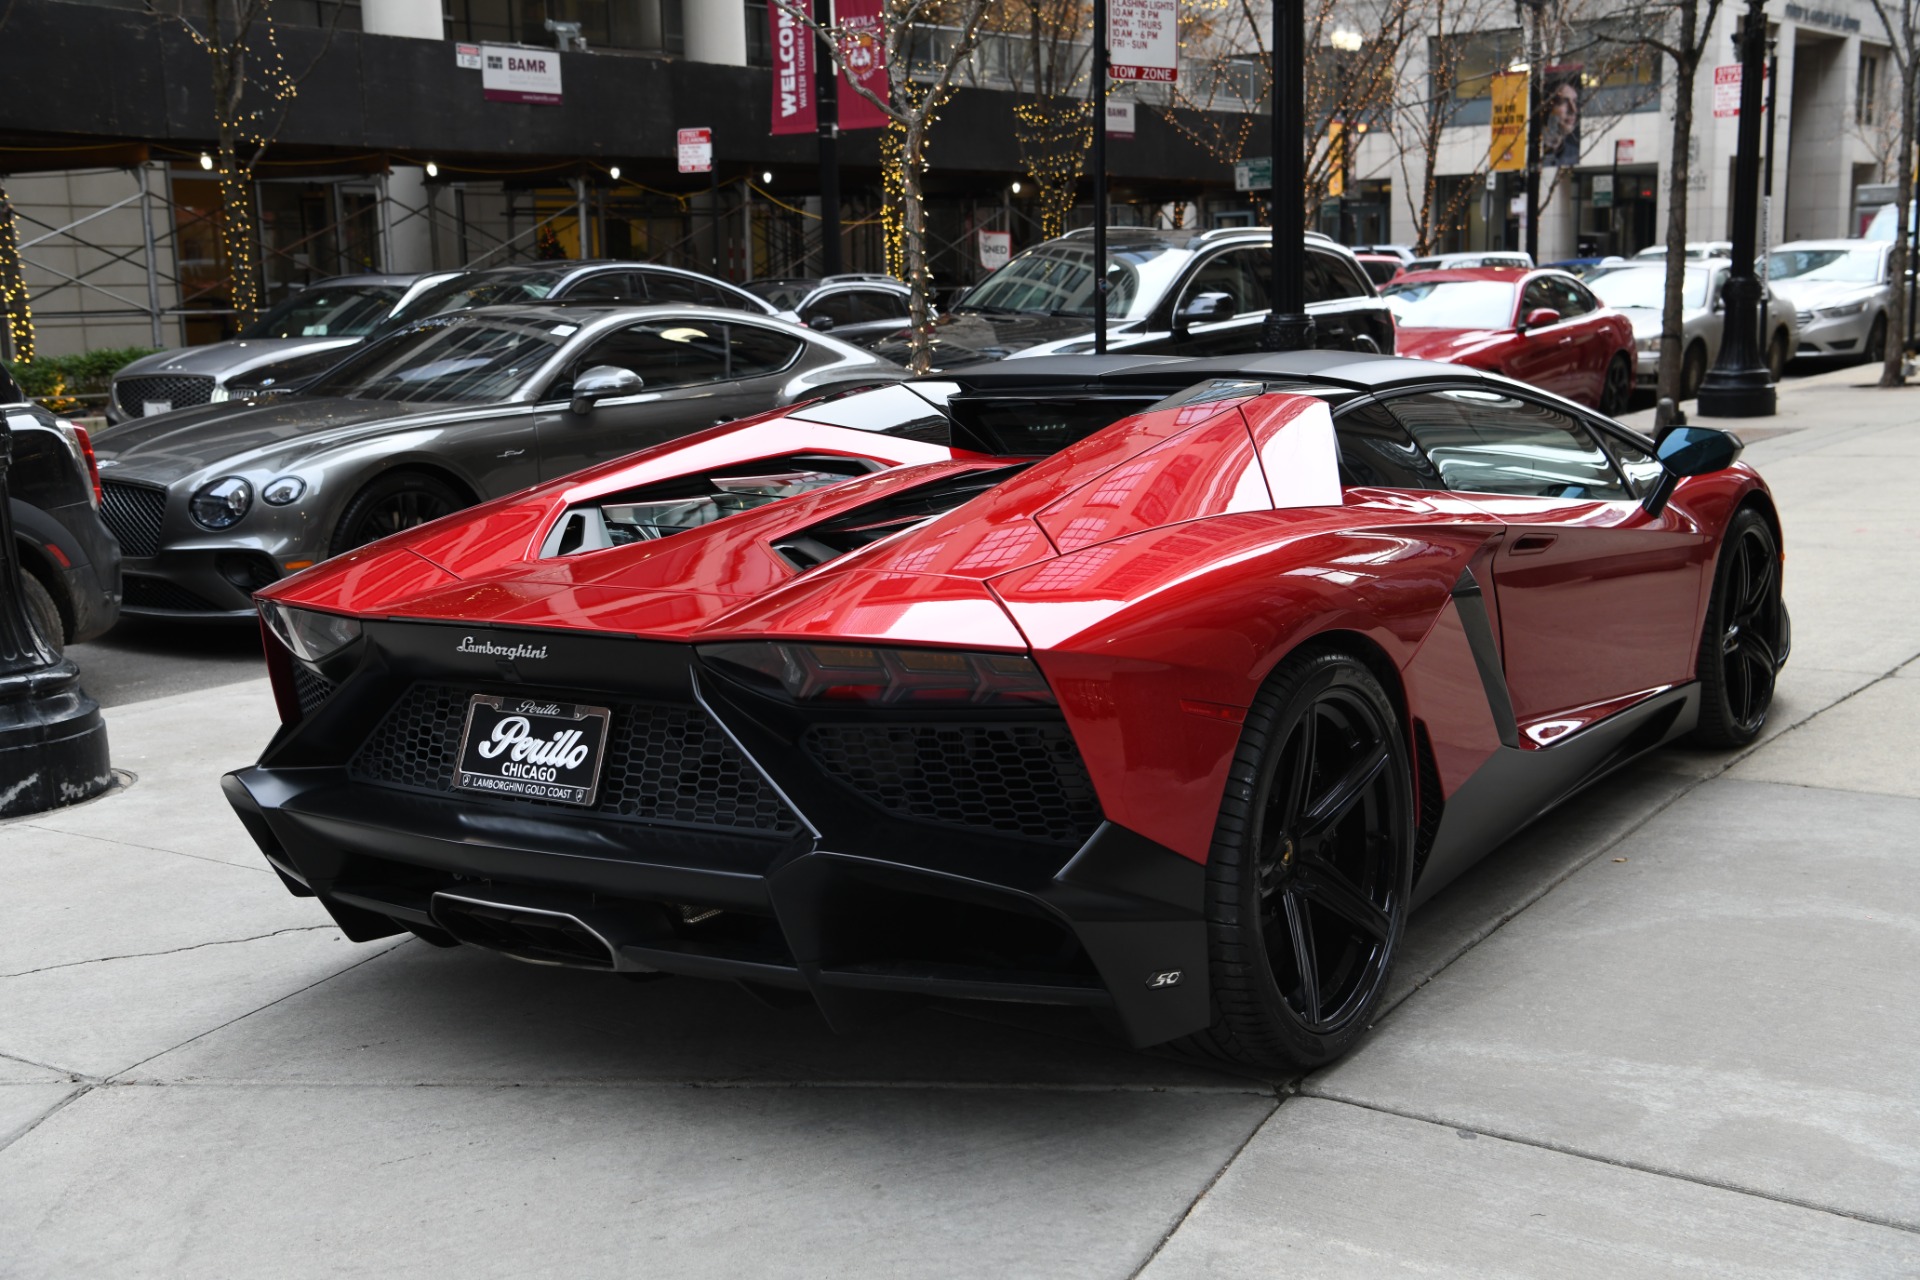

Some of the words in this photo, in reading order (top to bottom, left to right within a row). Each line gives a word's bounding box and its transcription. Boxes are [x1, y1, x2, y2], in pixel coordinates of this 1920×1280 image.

[1112, 0, 1149, 9] FLASHING
[1149, 1, 1175, 11] LIGHTS
[1112, 8, 1121, 16] 10
[1121, 9, 1134, 17] AM
[1140, 10, 1146, 19] 8
[1147, 11, 1159, 19] PM
[1112, 18, 1129, 27] MON
[1137, 20, 1162, 30] THURS
[1112, 28, 1120, 38] 10
[1121, 29, 1133, 38] AM
[1140, 31, 1146, 40] 6
[1146, 31, 1158, 40] PM
[1112, 38, 1125, 48] FRI
[1131, 40, 1148, 49] SUN
[797, 38, 806, 73] TOWER
[508, 57, 547, 74] BAMR
[1112, 66, 1137, 79] TOW
[1141, 67, 1172, 80] ZONE
[798, 74, 807, 108] WATER
[456, 636, 548, 660] Lamborghini
[516, 700, 560, 715] Perillo
[478, 716, 589, 770] Perillo
[501, 761, 557, 782] CHICAGO
[472, 777, 525, 793] LAMBORGHINI
[525, 783, 546, 796] GOLD
[547, 786, 572, 799] COAST
[1151, 971, 1181, 987] 50
